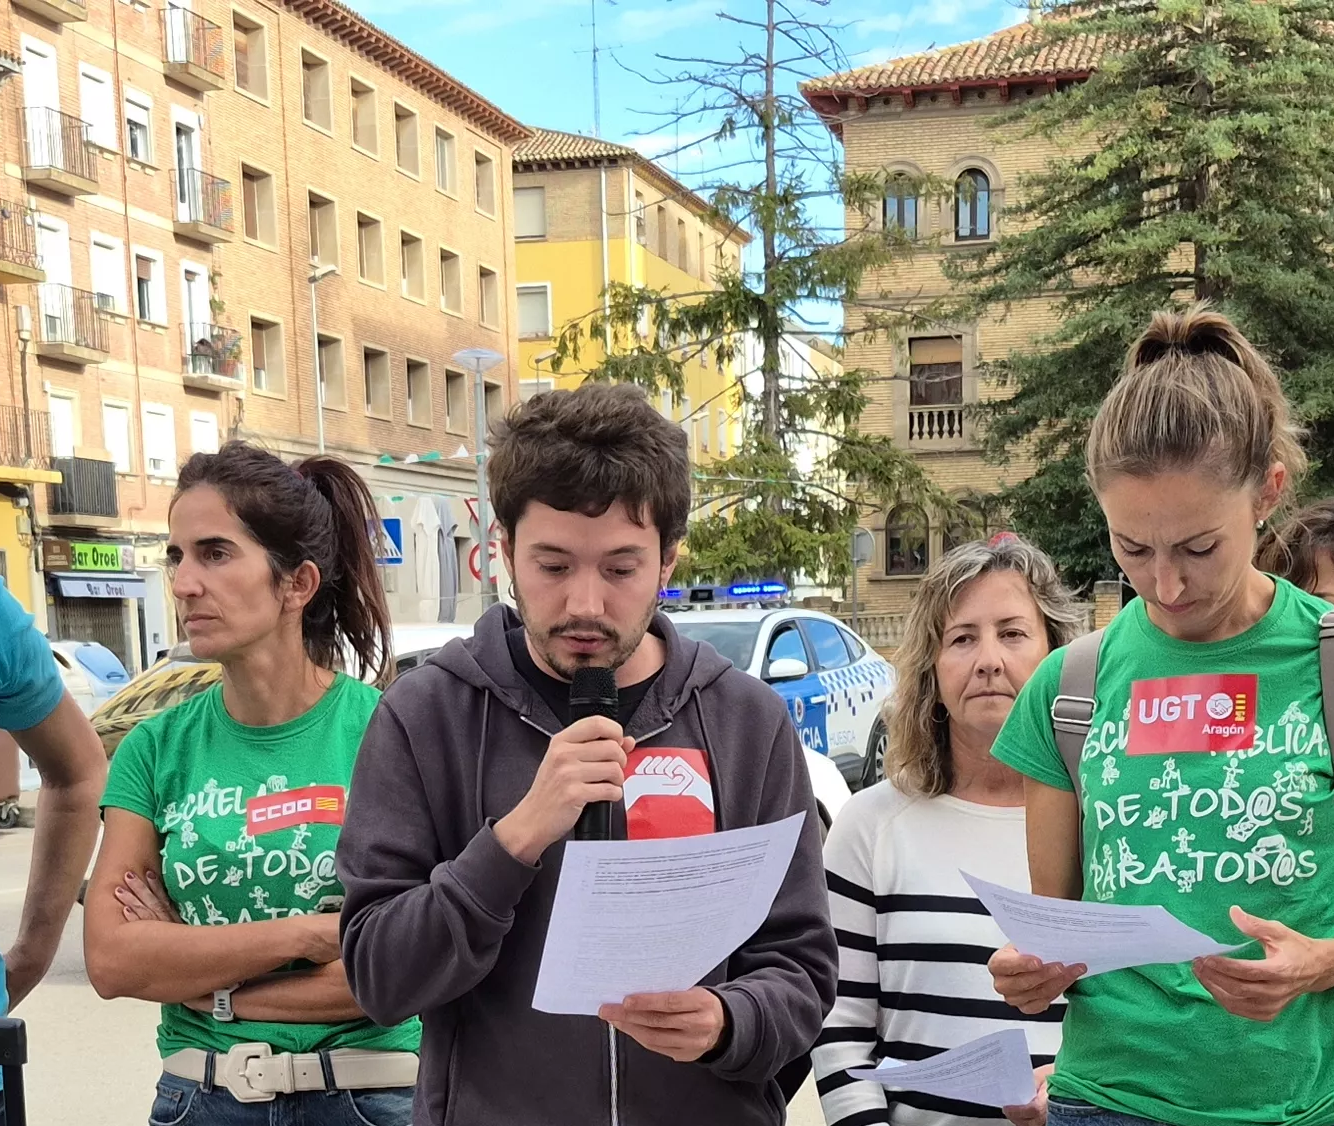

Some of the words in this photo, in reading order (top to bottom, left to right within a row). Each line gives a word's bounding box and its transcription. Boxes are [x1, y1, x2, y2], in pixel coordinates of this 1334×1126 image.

[92, 546, 119, 567] Oroel
[106, 583, 125, 596] Oroel
[1138, 694, 1201, 723] UGT
[1202, 724, 1244, 737] Aragón
[251, 798, 312, 823] CCOO
[1095, 794, 1141, 830] DE
[1163, 787, 1304, 826] TOD@S
[174, 855, 218, 889] DE
[238, 849, 336, 886] TOD@
[1090, 852, 1177, 891] PARA
[1188, 850, 1318, 886] TOD@S
